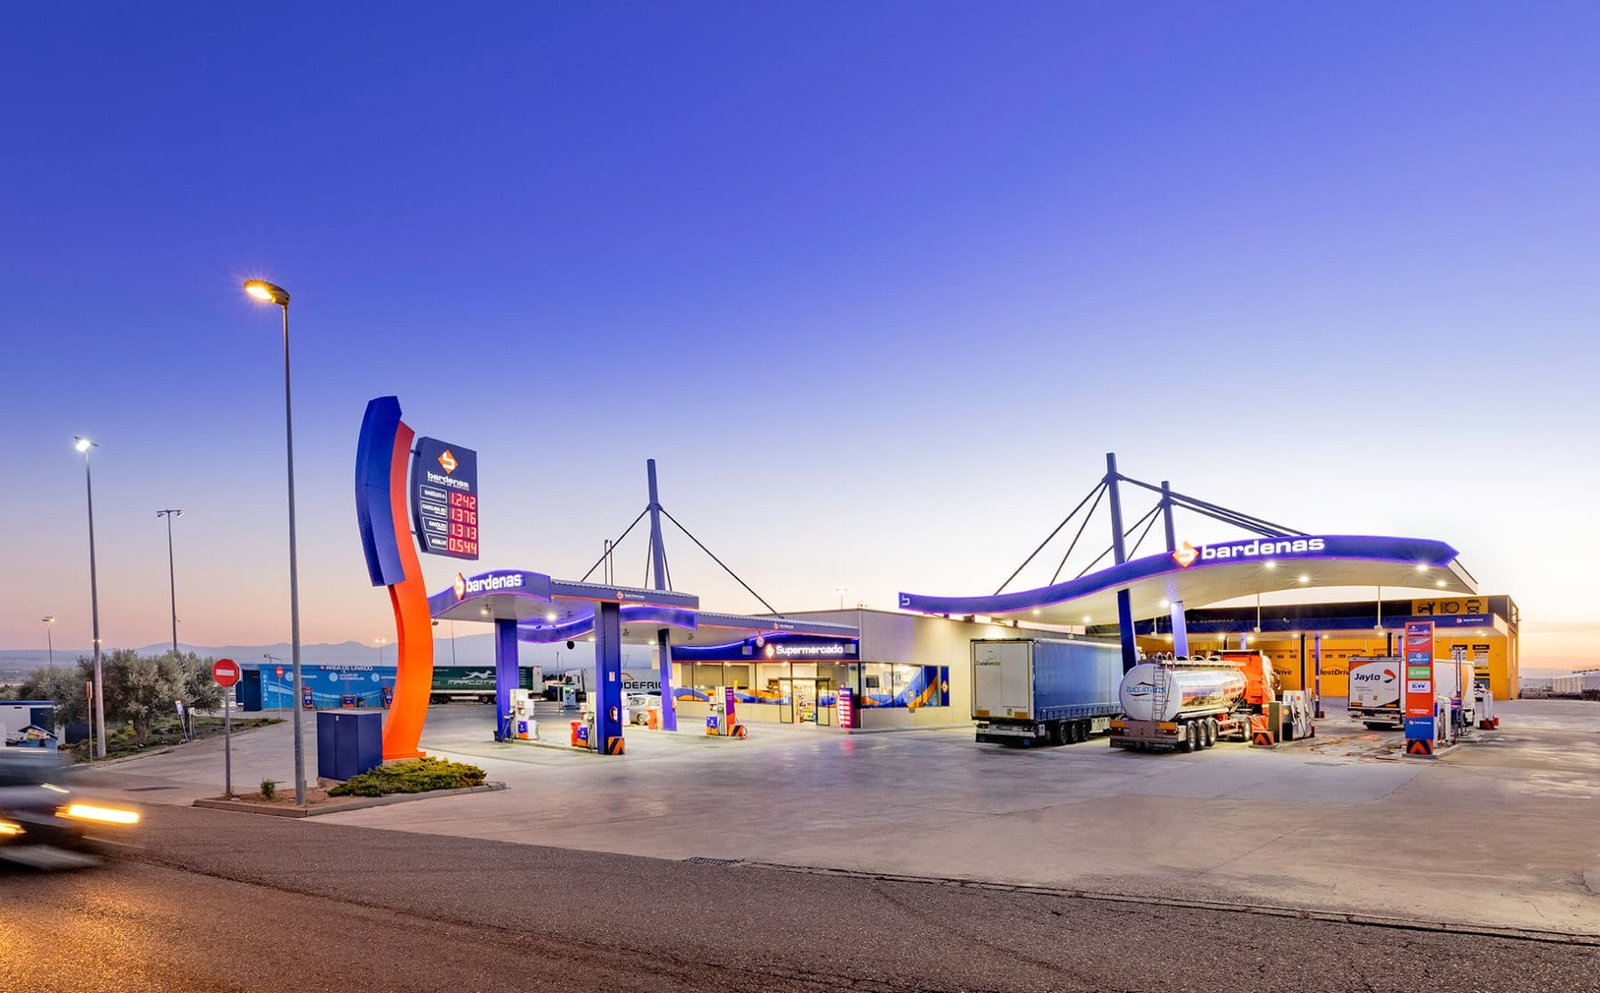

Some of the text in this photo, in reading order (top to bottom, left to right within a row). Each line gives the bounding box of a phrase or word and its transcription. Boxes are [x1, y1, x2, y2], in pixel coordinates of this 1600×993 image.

[427, 471, 470, 488] bardenas
[451, 492, 476, 510] 1.242
[451, 508, 477, 525] 1.376
[452, 523, 477, 540] 1.313
[449, 537, 477, 554] 0.544
[1201, 538, 1325, 559] bardenas
[465, 573, 523, 592] bardenas
[776, 645, 843, 656] Supermercado
[621, 681, 662, 689] DEFRI
